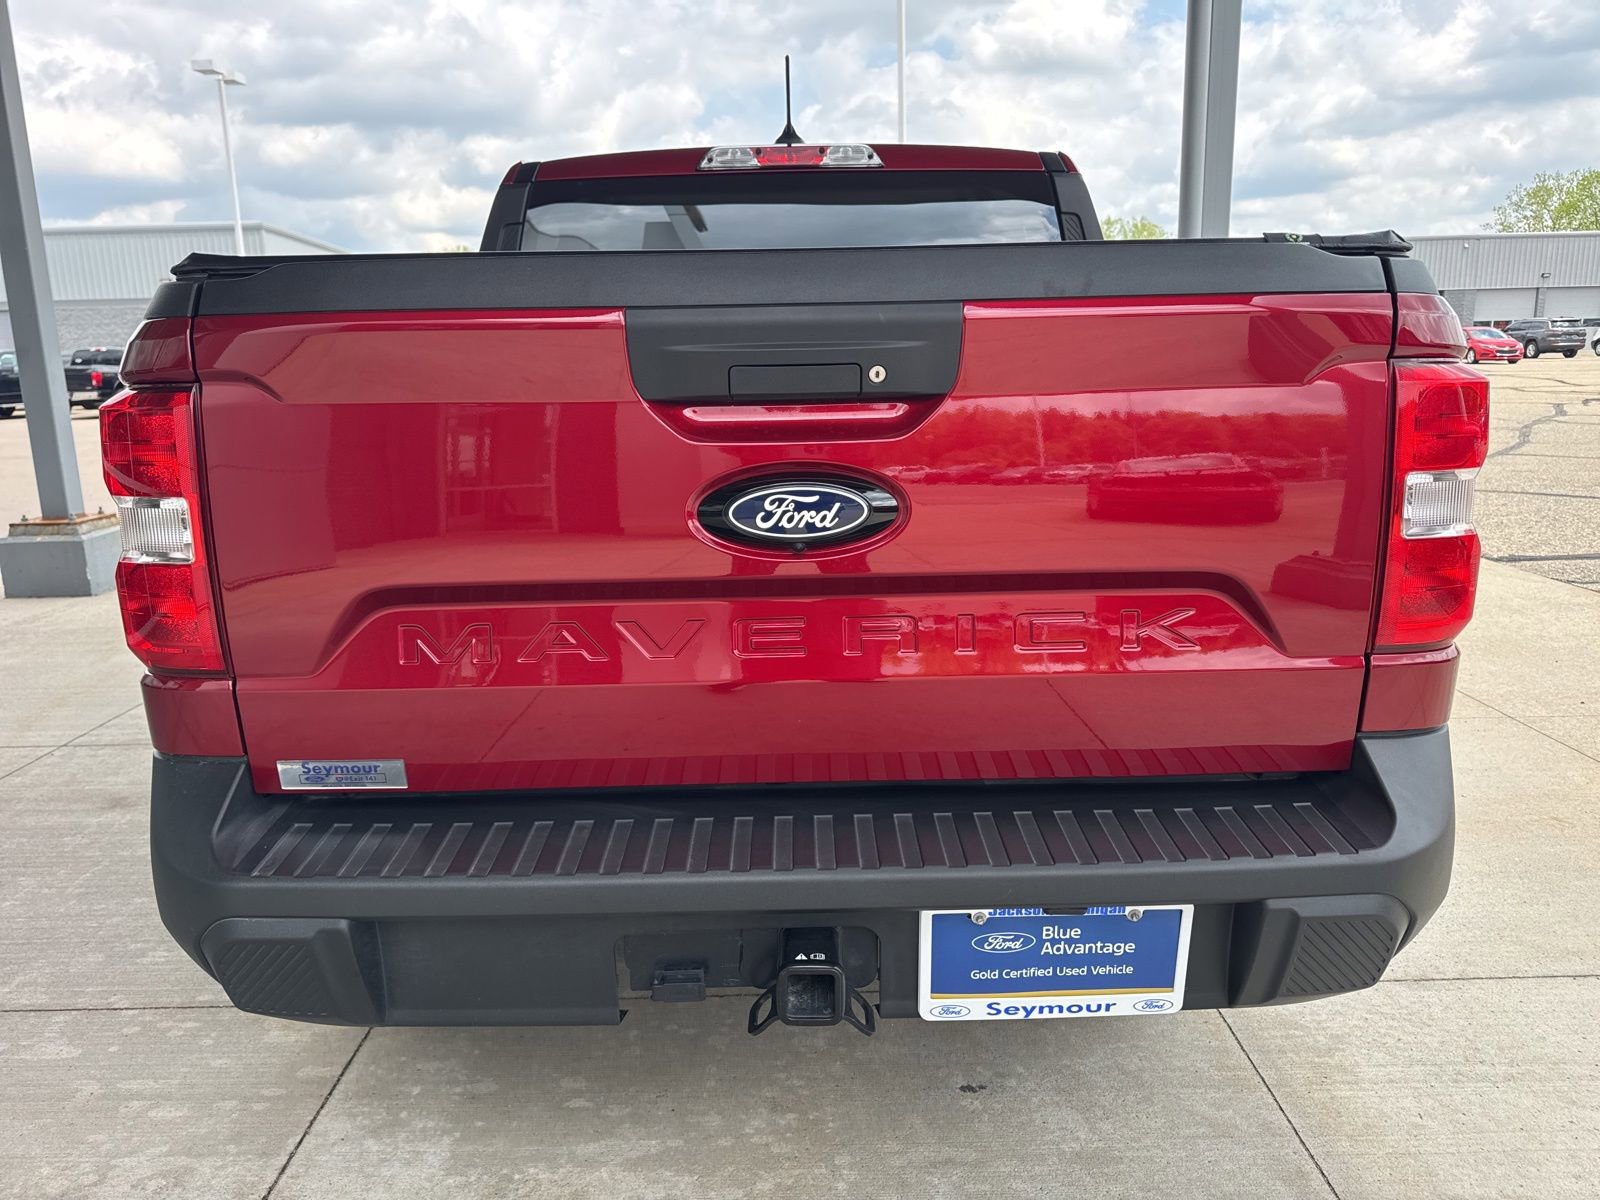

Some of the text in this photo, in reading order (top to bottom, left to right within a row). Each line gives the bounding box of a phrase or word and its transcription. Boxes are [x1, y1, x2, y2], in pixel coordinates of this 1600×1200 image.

[755, 494, 842, 529] Ford
[397, 607, 1200, 666] MAVERICK
[301, 761, 381, 777] Seymour
[1042, 926, 1081, 939] Blue
[983, 934, 1025, 950] Ford
[1041, 940, 1136, 956] Advantage
[970, 964, 1134, 980] Gold Certified Used Vehicle
[938, 1000, 1166, 1018] Ford Seymour Ford
